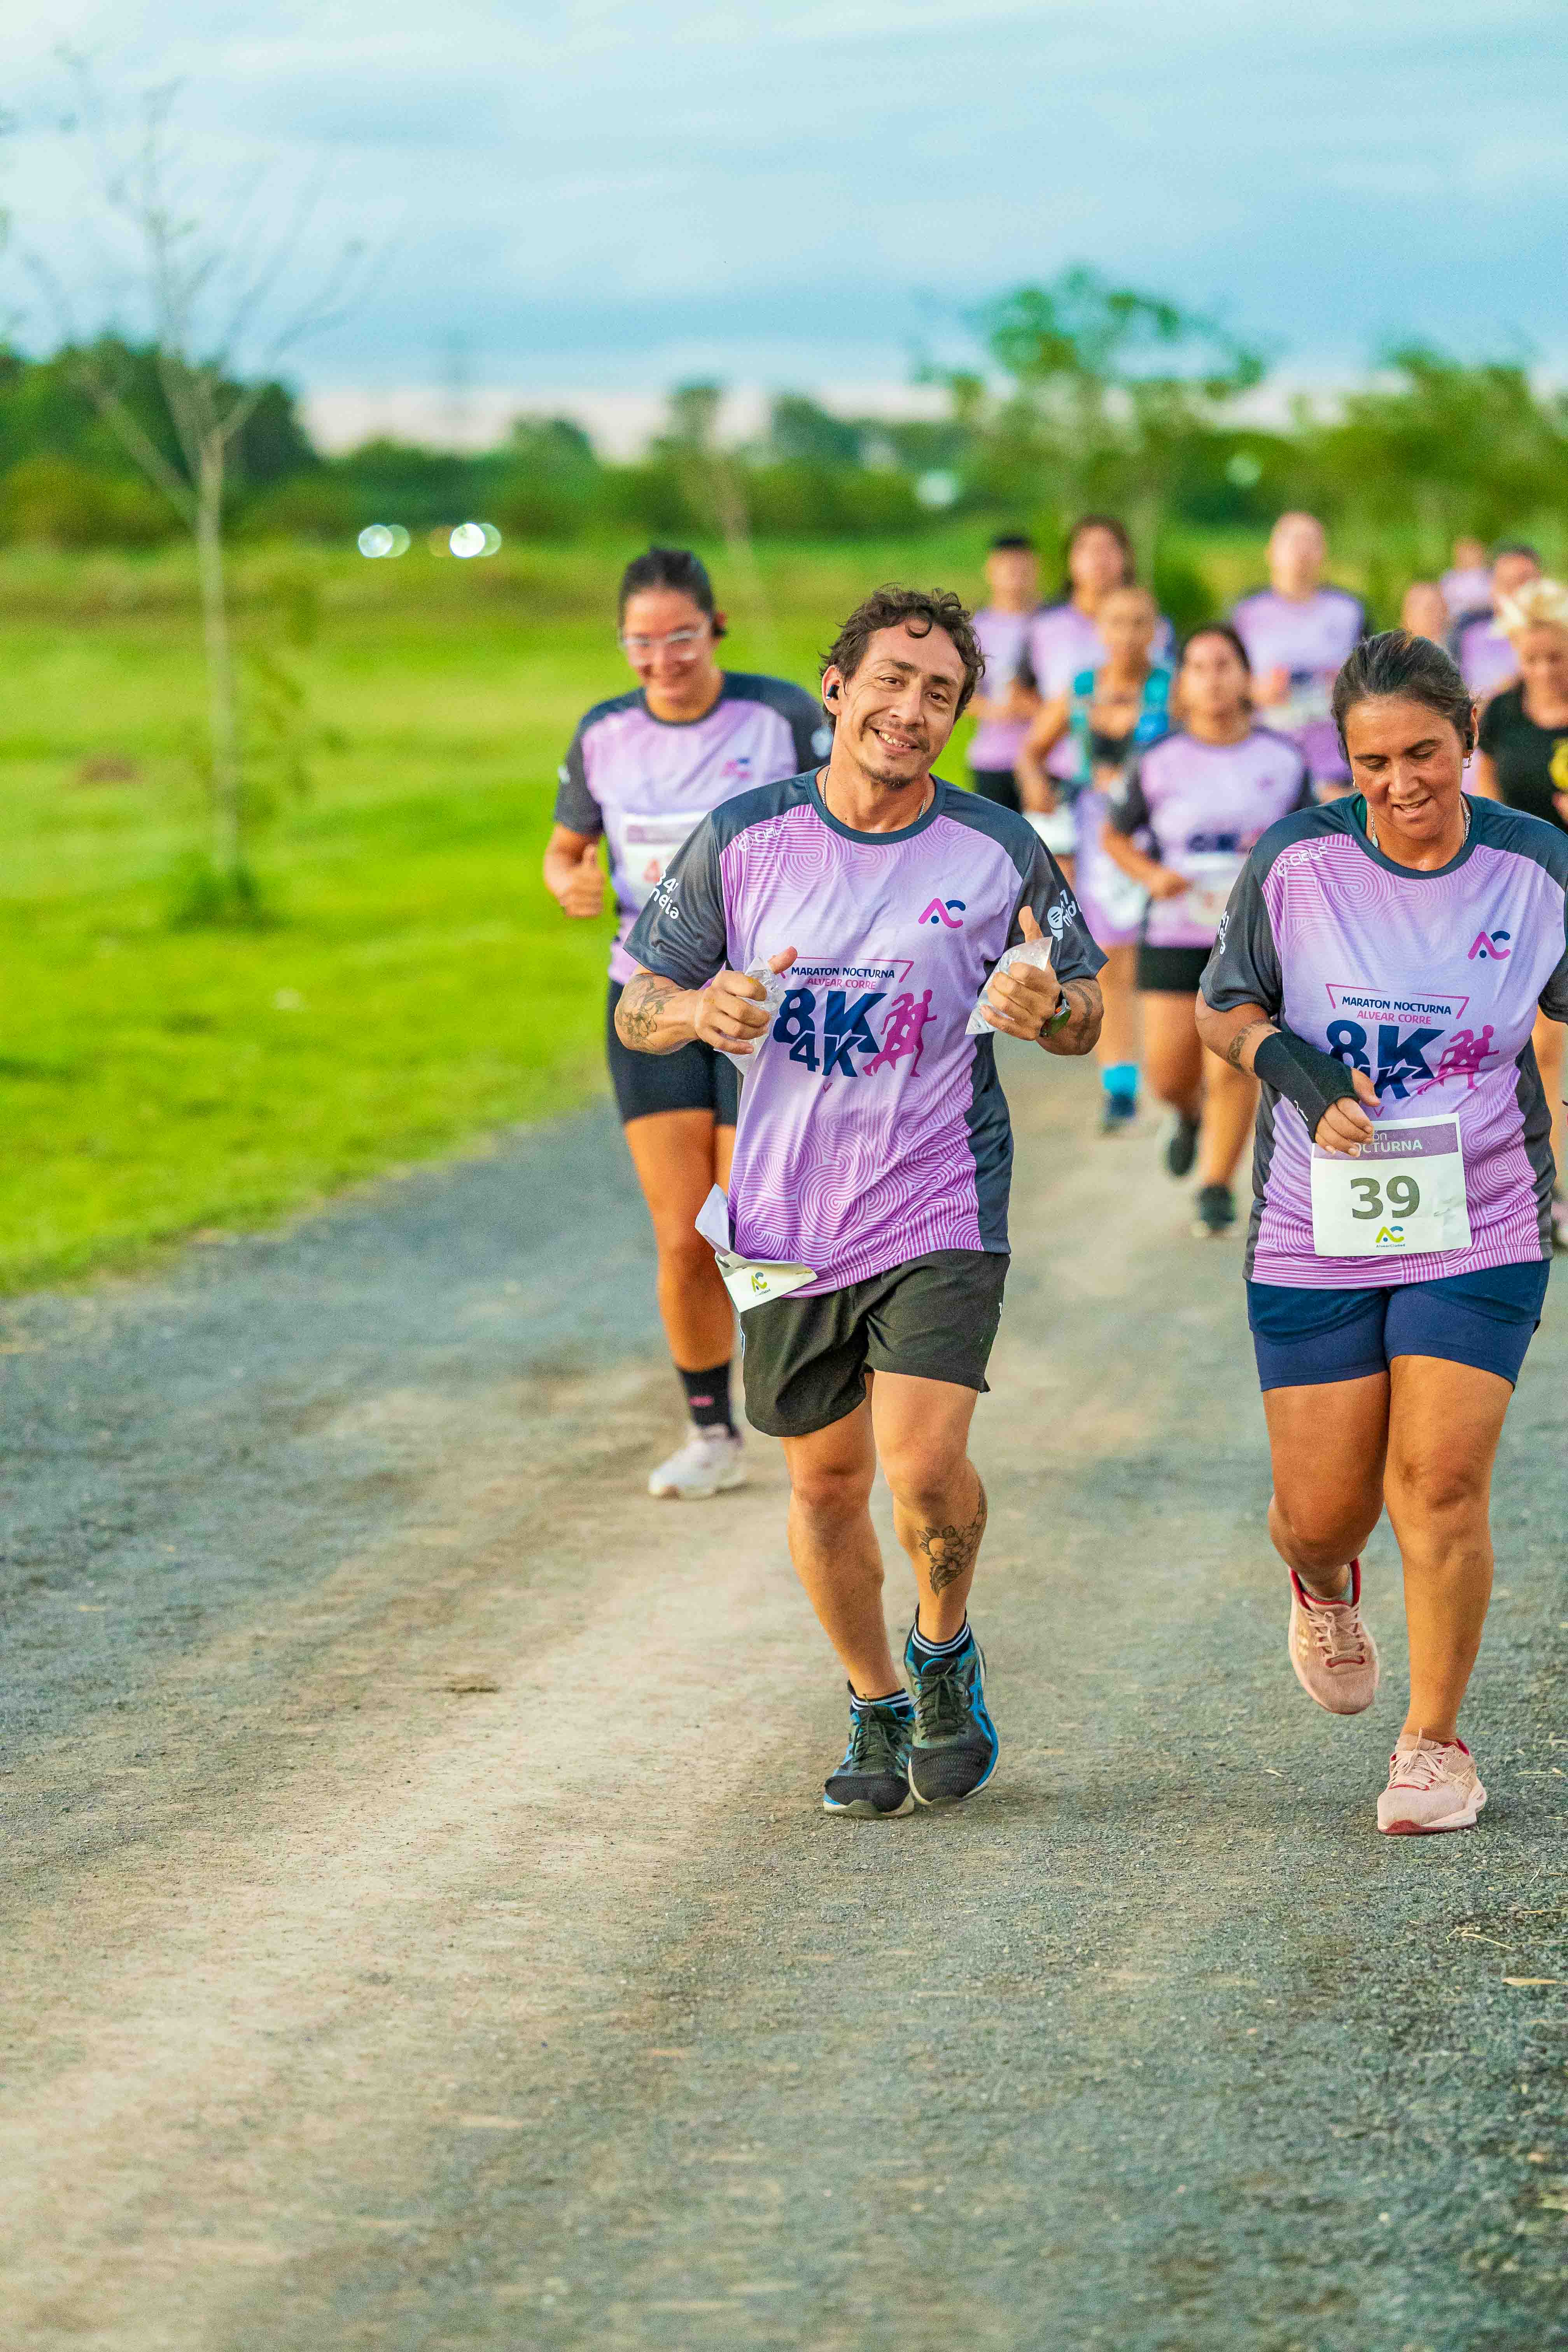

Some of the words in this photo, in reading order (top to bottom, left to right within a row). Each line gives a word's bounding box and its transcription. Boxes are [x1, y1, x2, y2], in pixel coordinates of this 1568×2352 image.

[918, 898, 966, 928] AC
[1468, 931, 1511, 960] AC
[791, 967, 839, 976] MARATON
[843, 968, 894, 978] NOCTURNA
[807, 978, 842, 987] ALVEAR
[845, 979, 876, 990] CORRE
[1342, 996, 1390, 1010] MARATON
[1394, 1001, 1451, 1015] NOCTURNA
[1356, 1010, 1394, 1022] ALVEAR
[1398, 1014, 1432, 1025] CORRE
[773, 988, 888, 1053] 8K
[789, 1031, 867, 1077] 4K
[1326, 1020, 1446, 1079] 8K
[1350, 1176, 1420, 1219] 39
